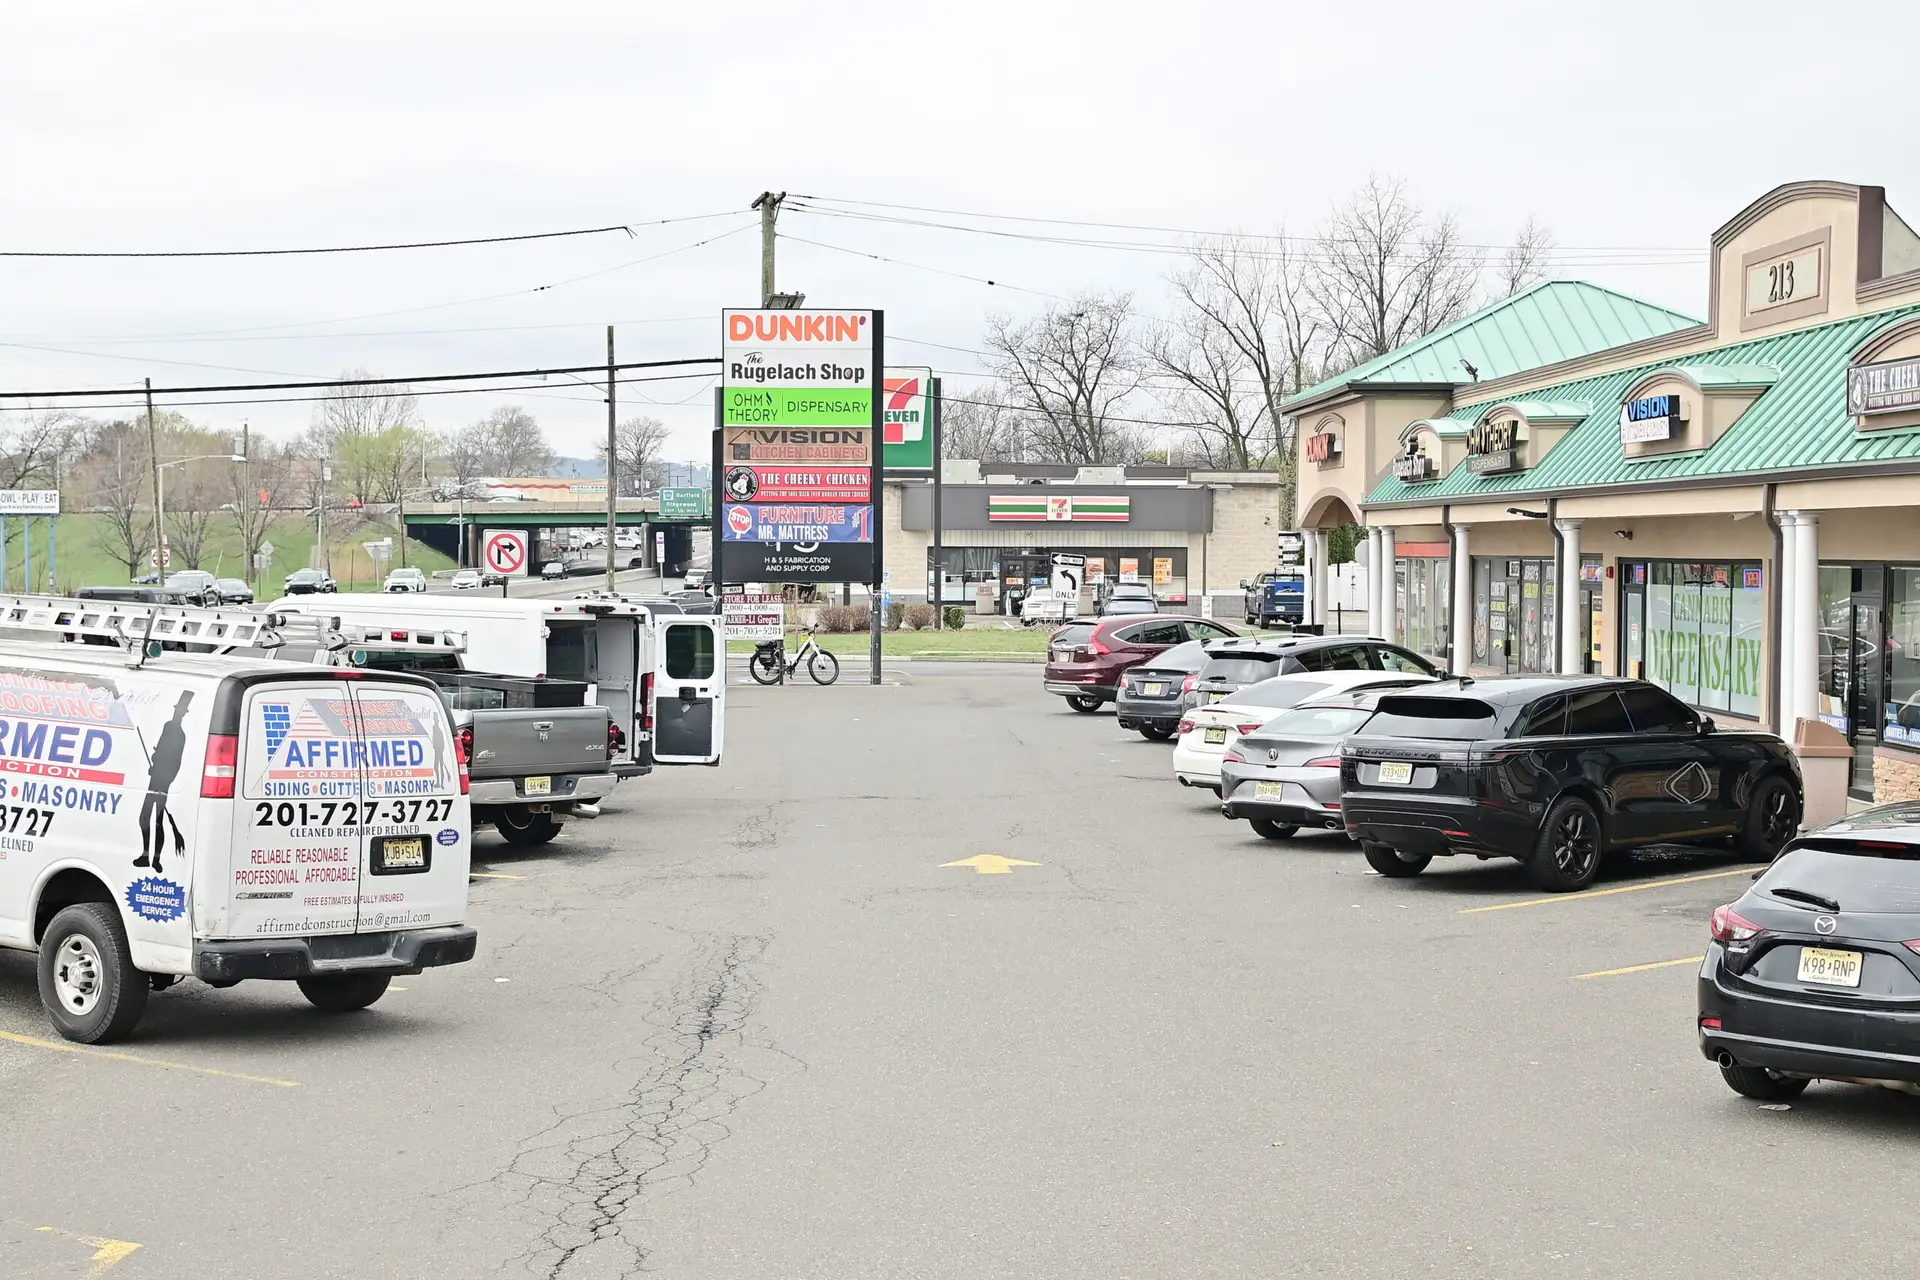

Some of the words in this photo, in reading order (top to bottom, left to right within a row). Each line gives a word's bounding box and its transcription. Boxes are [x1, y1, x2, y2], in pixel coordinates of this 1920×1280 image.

[1768, 260, 1795, 303] 213
[729, 314, 867, 342] DUNKIN'
[744, 351, 765, 365] The
[731, 363, 817, 383] Rugelach
[820, 363, 865, 383] Shop
[1869, 369, 1886, 394] THE
[1889, 363, 1920, 391] CHEEK
[734, 394, 763, 406] OHM
[787, 400, 869, 413] DISPENSARY
[728, 408, 778, 422] THEORY
[1628, 395, 1669, 421] VISION
[757, 430, 863, 444] VISION
[751, 446, 801, 459] KITCHEN
[806, 445, 865, 459] CABINETS
[1471, 455, 1506, 470] DISPENSARY
[761, 473, 780, 485] THE
[784, 473, 822, 485] CHEEKY
[826, 473, 868, 485] CHICKEN
[0, 493, 17, 504] OWL
[22, 493, 40, 504] PLAY
[45, 493, 57, 504] EAT
[758, 506, 845, 524] FURNITURE
[1052, 498, 1067, 519] 7
[730, 511, 751, 525] STOP
[758, 525, 775, 540] MR.
[778, 525, 829, 540] MATTRESS
[724, 595, 745, 604] STORE
[746, 595, 760, 604] FOR
[761, 595, 782, 604] LEASE
[1056, 591, 1077, 600] ONLY
[1673, 593, 1731, 625] CANNABIS
[1648, 629, 1762, 697] DISPENSARY
[0, 691, 110, 720] OOFING
[285, 739, 425, 768] AFFIRMED
[5, 761, 80, 778] CTION
[296, 769, 413, 778] CONSTRUCTION
[264, 782, 310, 796] SIDING
[384, 779, 435, 795] MASONRY
[22, 781, 122, 814] MASONRY
[256, 799, 454, 827] 201-727-3727
[290, 828, 334, 838] CLEANED
[336, 826, 383, 837] REPAIRED
[385, 825, 420, 835] RELINED
[1, 837, 34, 853] ELINED
[251, 849, 291, 864] RELIABLE
[295, 847, 348, 863] REASONABLE
[236, 869, 299, 885] PROFESSIONAL
[304, 867, 356, 883] AFFORDABLE
[141, 881, 152, 892] 24
[152, 885, 175, 896] HOUR
[248, 891, 294, 899] EXPRESS
[135, 893, 181, 908] EMERGENCE
[304, 897, 318, 906] FREE
[320, 896, 351, 905] ESTIMATES
[359, 894, 378, 904] FULLY
[379, 893, 405, 903] INSURED
[141, 905, 172, 917] SERVICE
[256, 910, 431, 932] affirmedconstruction@gmail.com
[1803, 956, 1825, 974] K98
[1833, 960, 1856, 978] RNP
